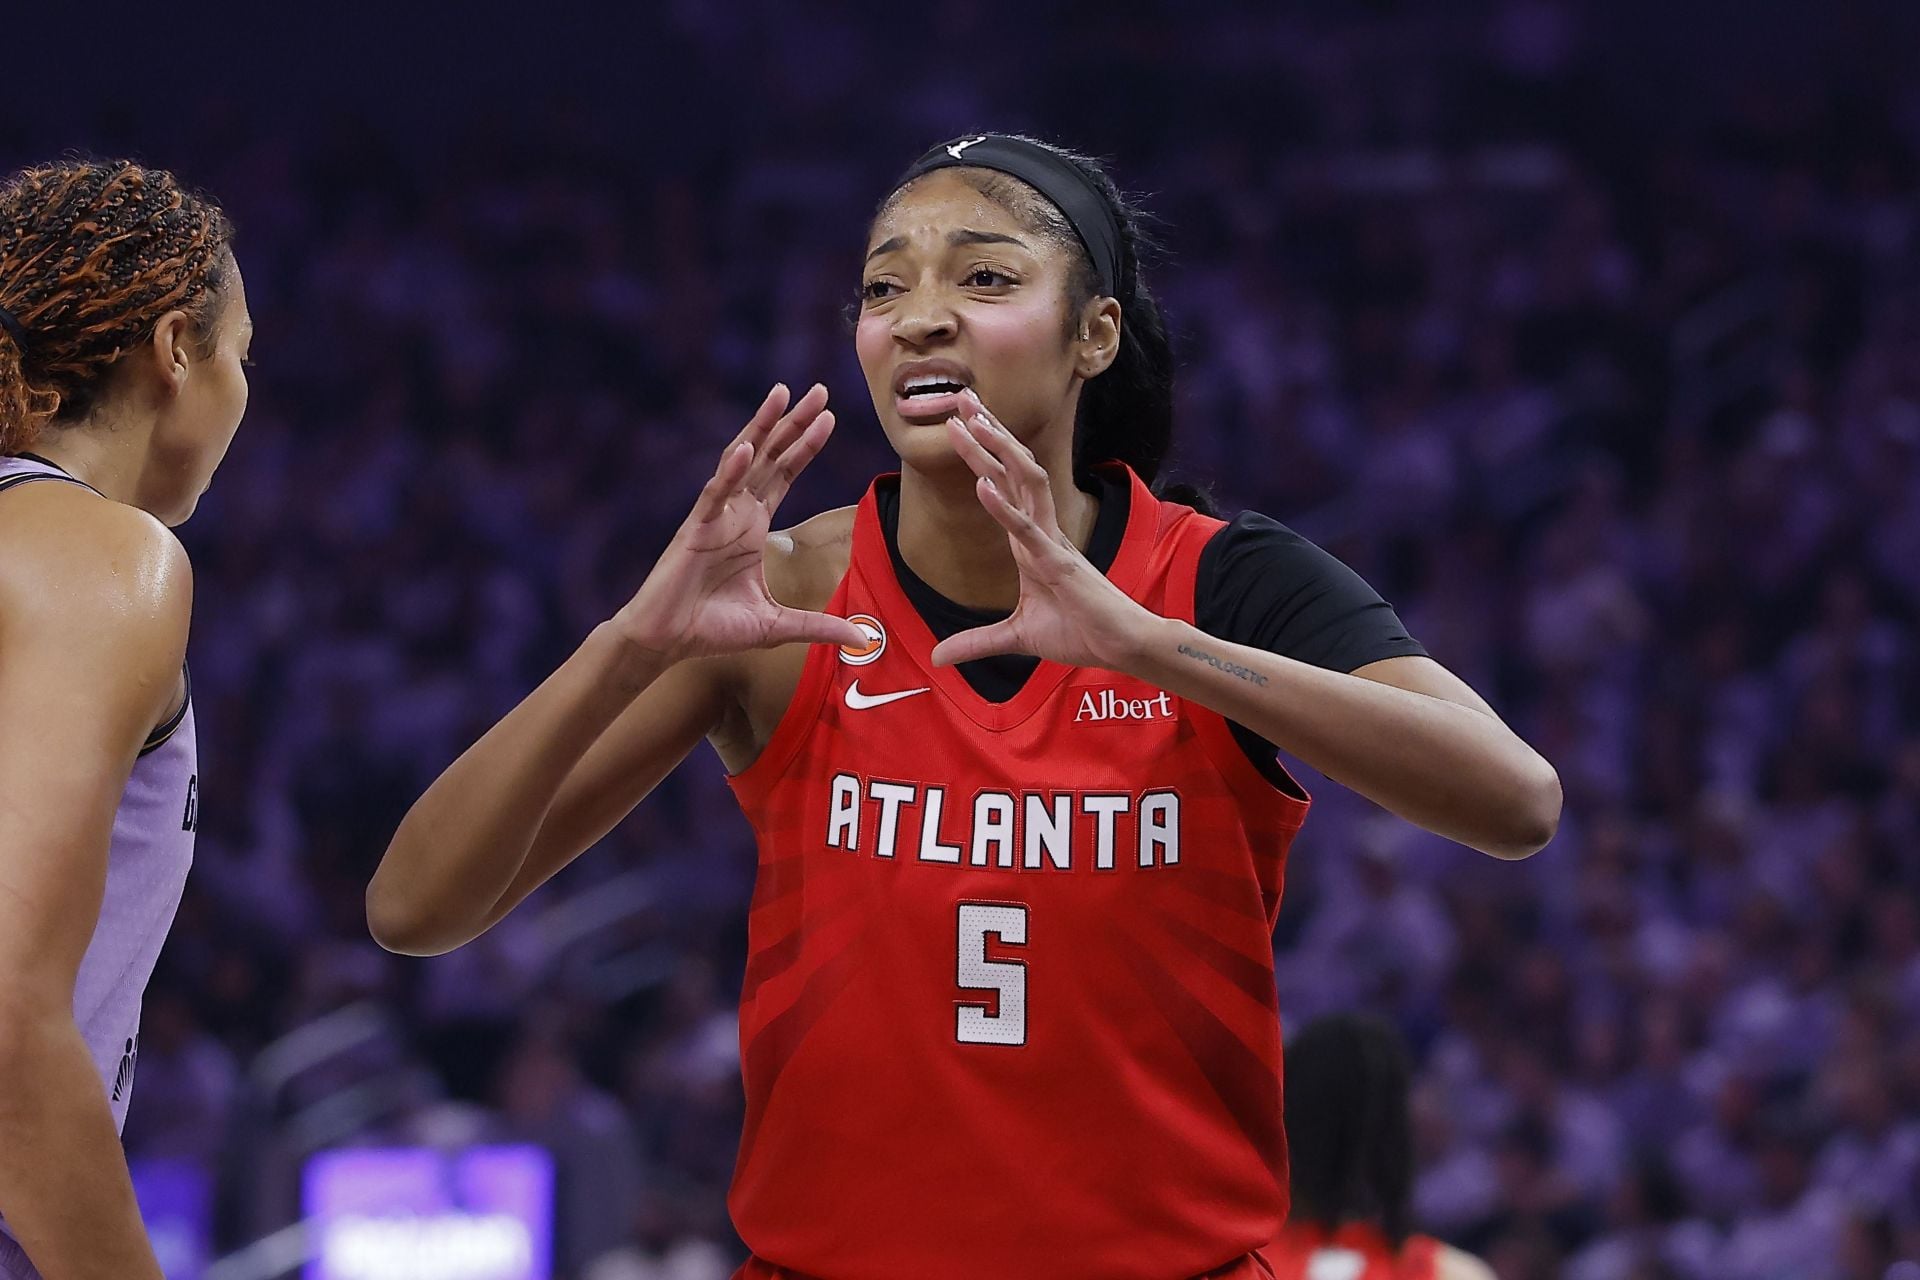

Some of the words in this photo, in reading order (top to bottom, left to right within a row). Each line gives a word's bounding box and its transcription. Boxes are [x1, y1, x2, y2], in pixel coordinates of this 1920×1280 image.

[1073, 689, 1174, 722] Albert
[825, 772, 1181, 871] ATLANTA
[955, 902, 1028, 1046] 5
